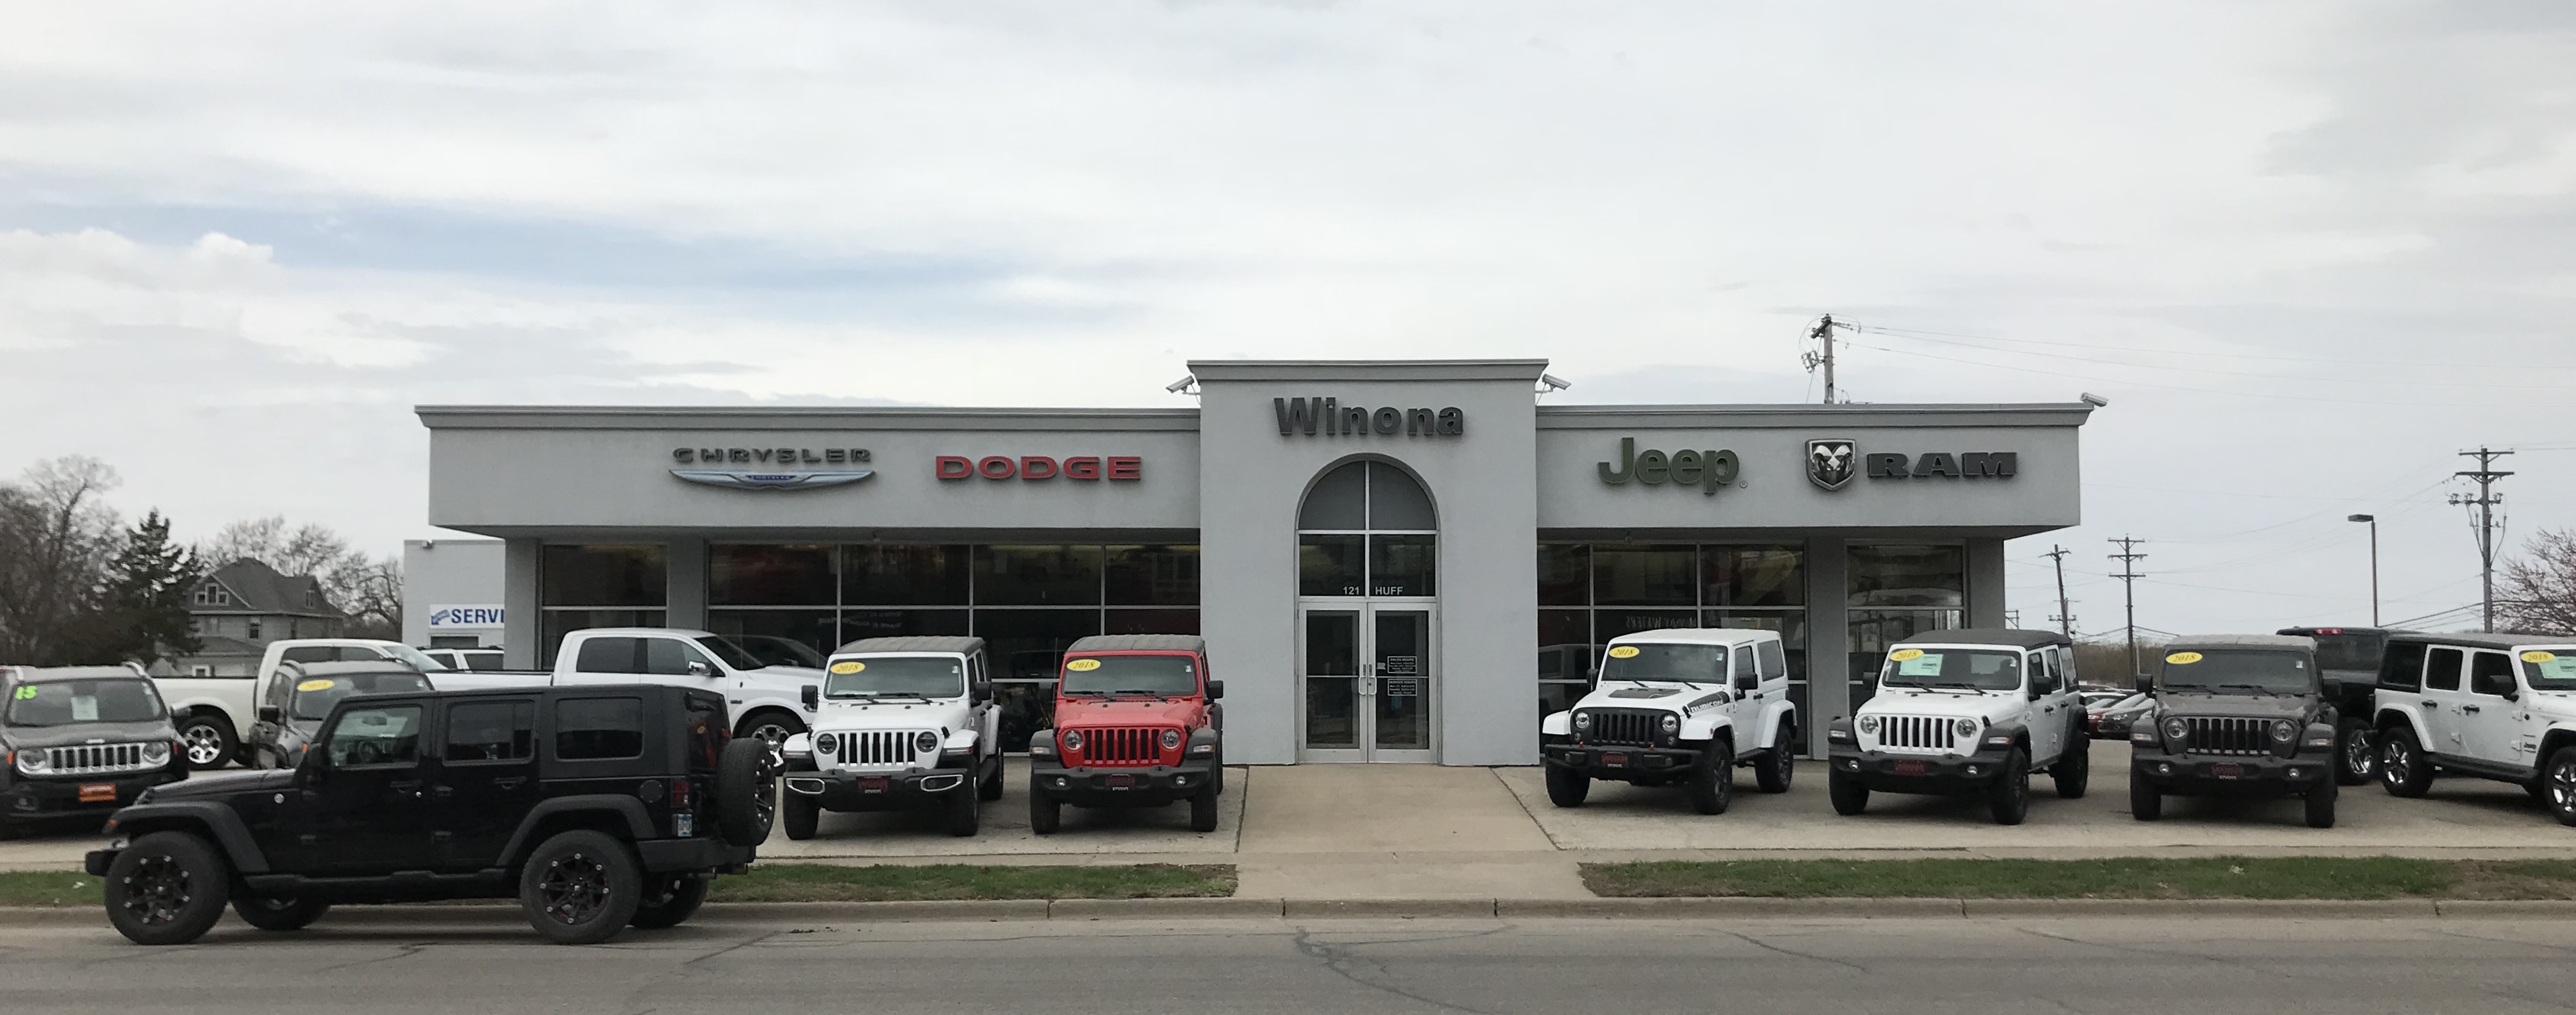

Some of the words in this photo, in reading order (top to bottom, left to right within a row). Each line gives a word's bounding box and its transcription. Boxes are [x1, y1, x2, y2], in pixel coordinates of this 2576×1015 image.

[1274, 397, 1463, 435] Winona
[673, 448, 871, 463] CHRYSLER
[936, 456, 1141, 480] DODGE
[1597, 437, 1739, 496] Jeep
[1867, 452, 2017, 476] RAM
[1343, 586, 1360, 595] 121
[1375, 586, 1404, 595] HUFF
[451, 608, 505, 624] SERVI
[1896, 650, 1919, 659] 2018
[2173, 654, 2196, 662] 2018
[835, 663, 860, 672] 2018
[16, 685, 37, 700] 15
[1690, 699, 1723, 712] RUBICON
